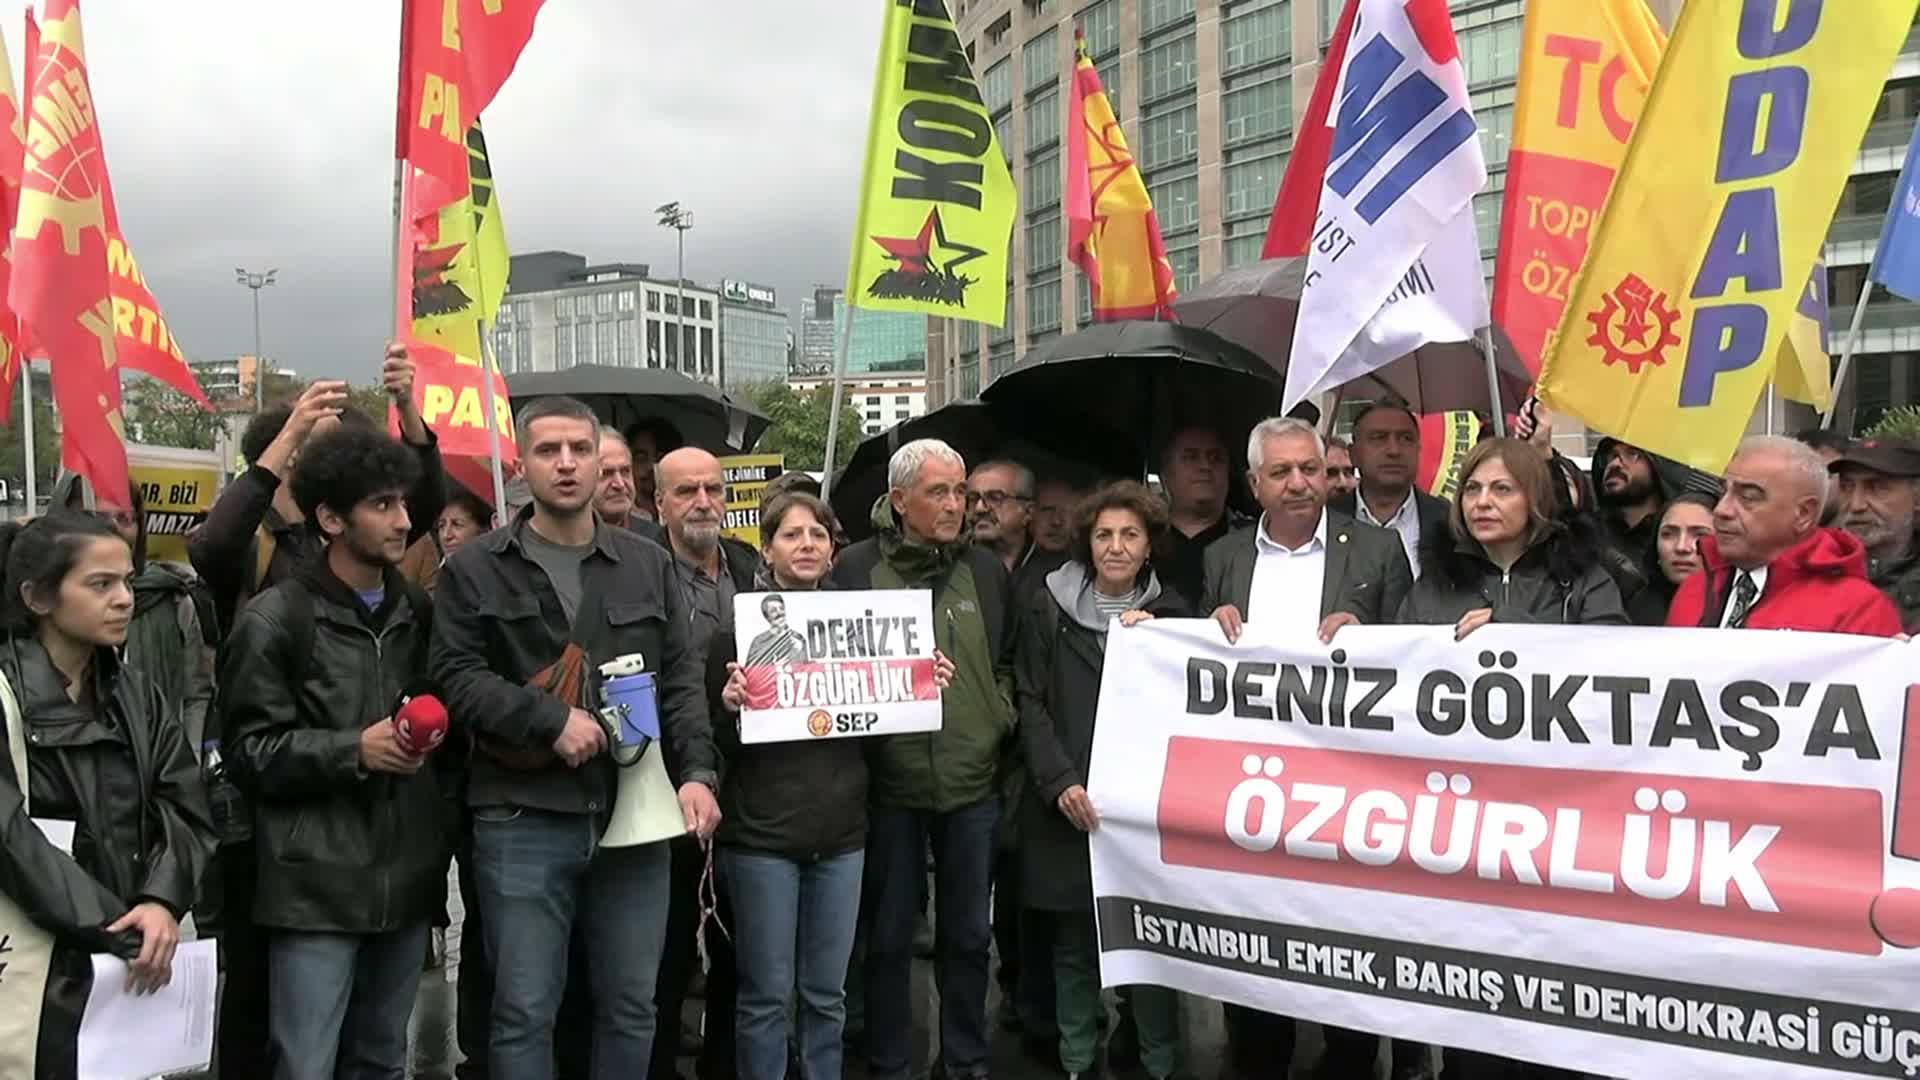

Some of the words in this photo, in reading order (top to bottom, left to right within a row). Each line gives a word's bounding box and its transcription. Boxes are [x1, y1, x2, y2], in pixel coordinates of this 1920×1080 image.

[422, 384, 516, 444] PAR
[169, 480, 198, 505] BİZİ
[807, 609, 920, 660] DENİZ'E
[776, 661, 915, 707] ÖZGÜRLÜK!
[1186, 648, 1397, 732] DENİZ
[1416, 650, 1881, 771] GÖKTAŞ'A
[836, 713, 878, 733] SEP
[1223, 754, 1781, 913] ÖZGÜRLÜK
[1133, 904, 1278, 968] İSTANBUL
[1287, 941, 1387, 990] EMEK,
[1396, 961, 1504, 1012] BARIŞ
[1515, 974, 1564, 1016] VE
[1573, 985, 1820, 1054] DEMOKRASİ
